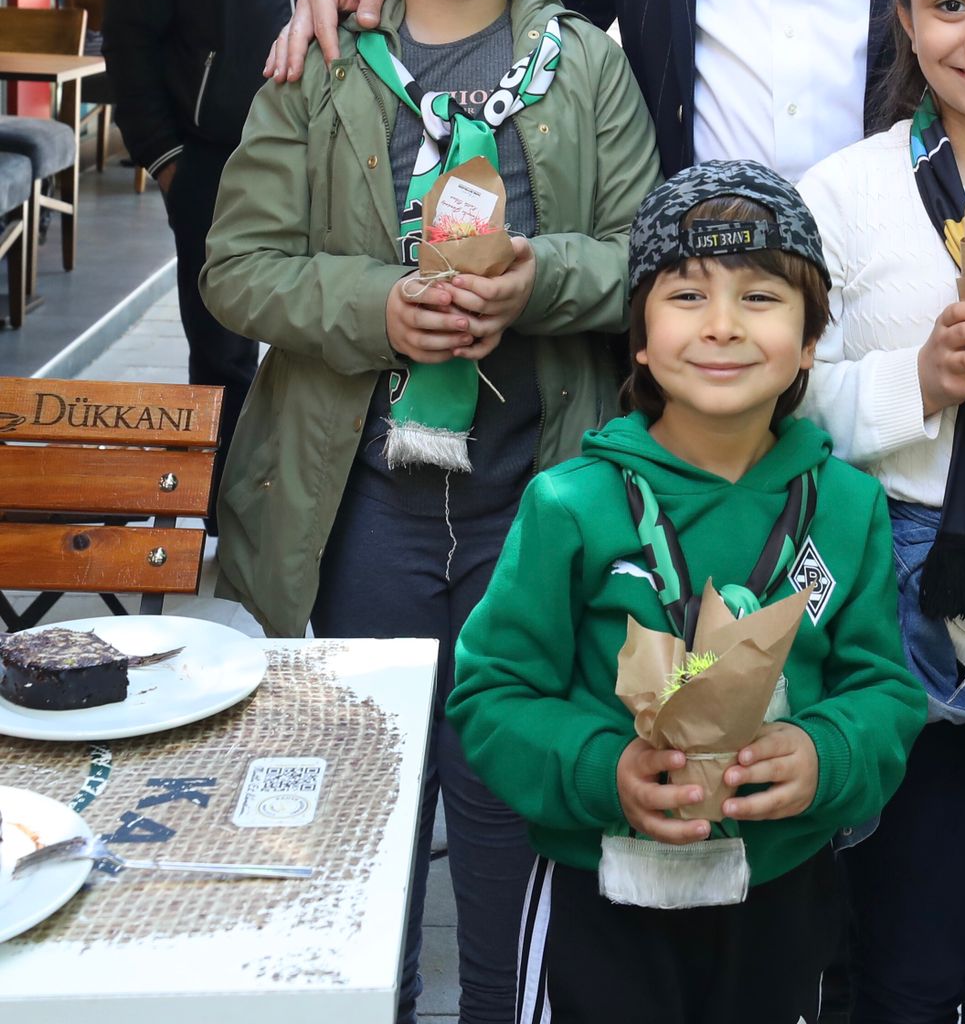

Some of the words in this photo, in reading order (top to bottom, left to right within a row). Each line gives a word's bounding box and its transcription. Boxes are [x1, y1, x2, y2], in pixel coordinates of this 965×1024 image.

[696, 233, 720, 248] JUST
[720, 230, 751, 246] BRAVE
[31, 392, 195, 432] DÜKKANI
